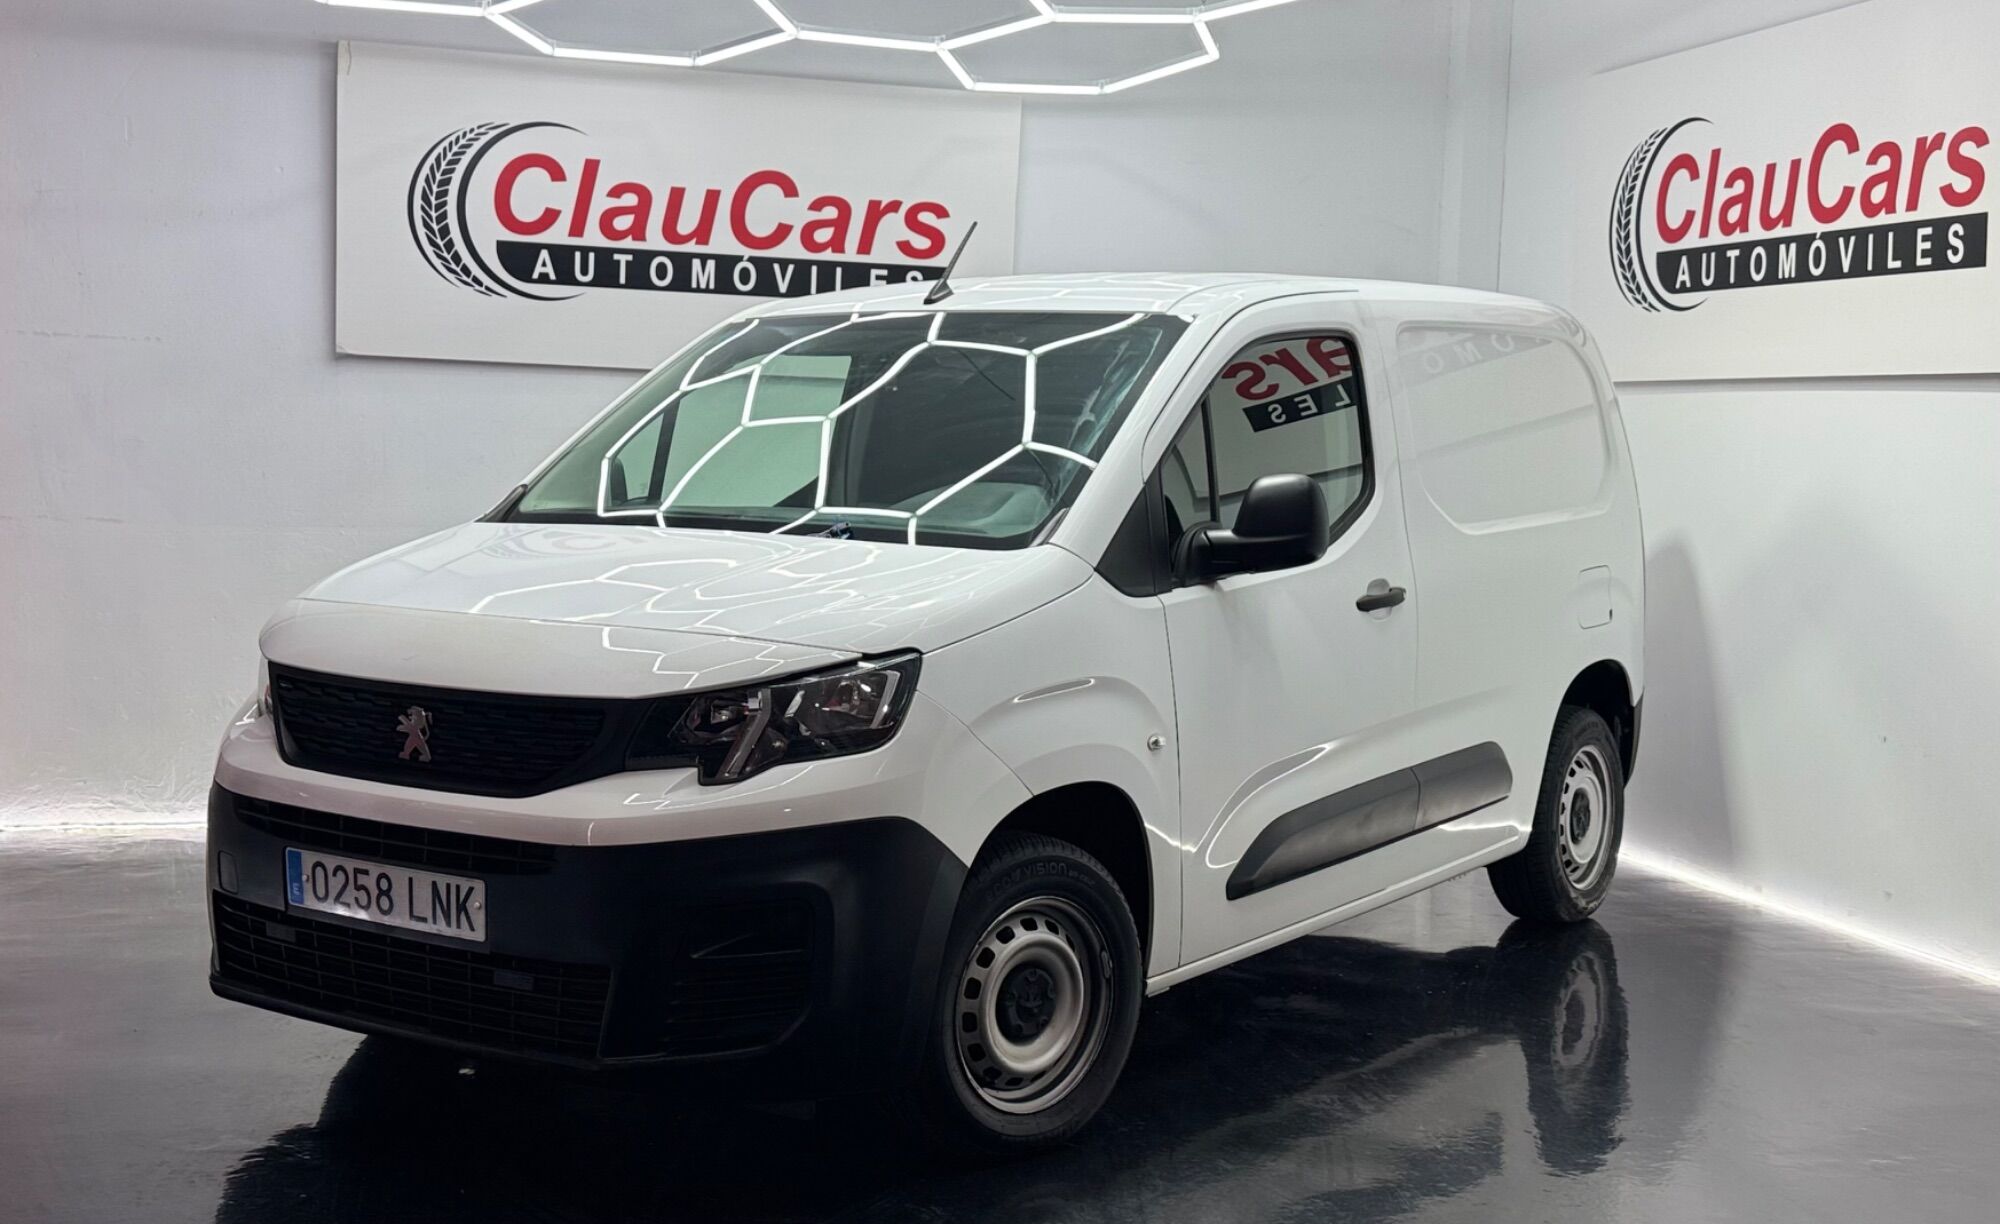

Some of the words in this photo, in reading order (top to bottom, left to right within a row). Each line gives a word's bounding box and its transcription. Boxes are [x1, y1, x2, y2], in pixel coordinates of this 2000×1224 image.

[494, 153, 951, 260] ClauCars
[1656, 123, 1990, 244] ClauCars
[1675, 222, 1965, 289] AUTOMÓVILES
[311, 860, 395, 916] 0258
[408, 876, 476, 932] LNK
